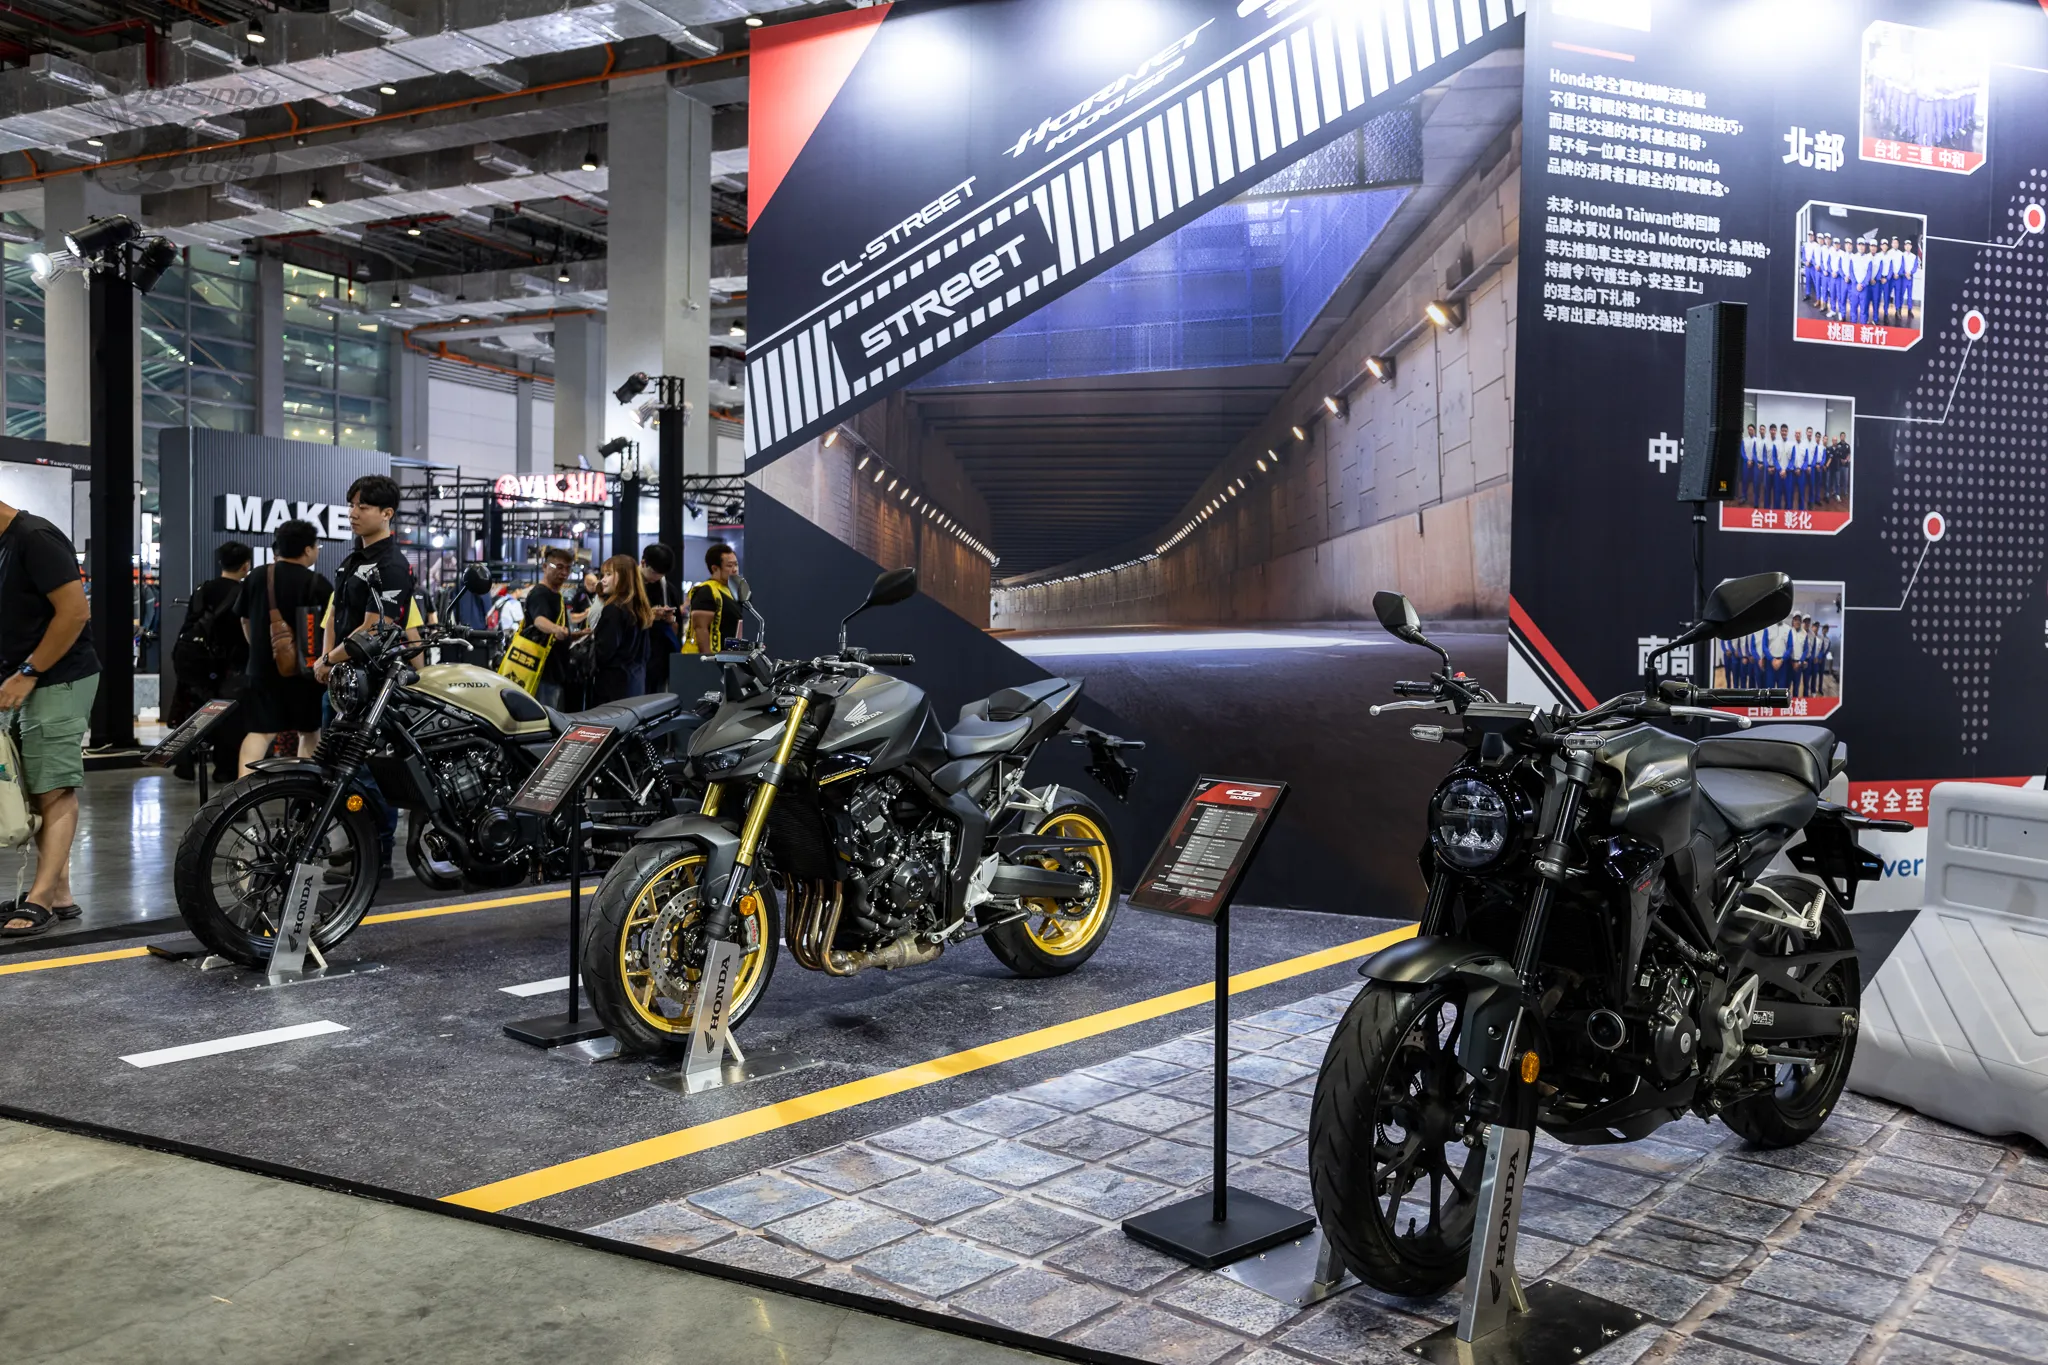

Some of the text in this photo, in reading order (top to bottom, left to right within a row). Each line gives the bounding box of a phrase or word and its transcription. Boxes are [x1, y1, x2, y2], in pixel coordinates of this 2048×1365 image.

[1782, 126, 1846, 172] 北部
[1874, 140, 1965, 169] 台北 三重 中和
[1679, 155, 1721, 175] Honda
[821, 175, 977, 287] CL-STREET
[1613, 226, 1656, 245] Honda
[1658, 235, 1728, 254] Motorcycle
[1543, 303, 1688, 334] 孕育出更為理想的交通社
[1827, 322, 1888, 346] 桃園 新竹
[1648, 432, 1684, 473] 中
[519, 472, 607, 504] YAMAHA
[1751, 509, 1812, 530] 台中 彰化
[850, 711, 884, 728] HONDA
[1650, 777, 1686, 796] HONDA
[1876, 853, 1924, 878] ver
[293, 875, 314, 935] HONDA
[710, 955, 731, 1031] HONDA
[1496, 1148, 1520, 1268] HONDA
